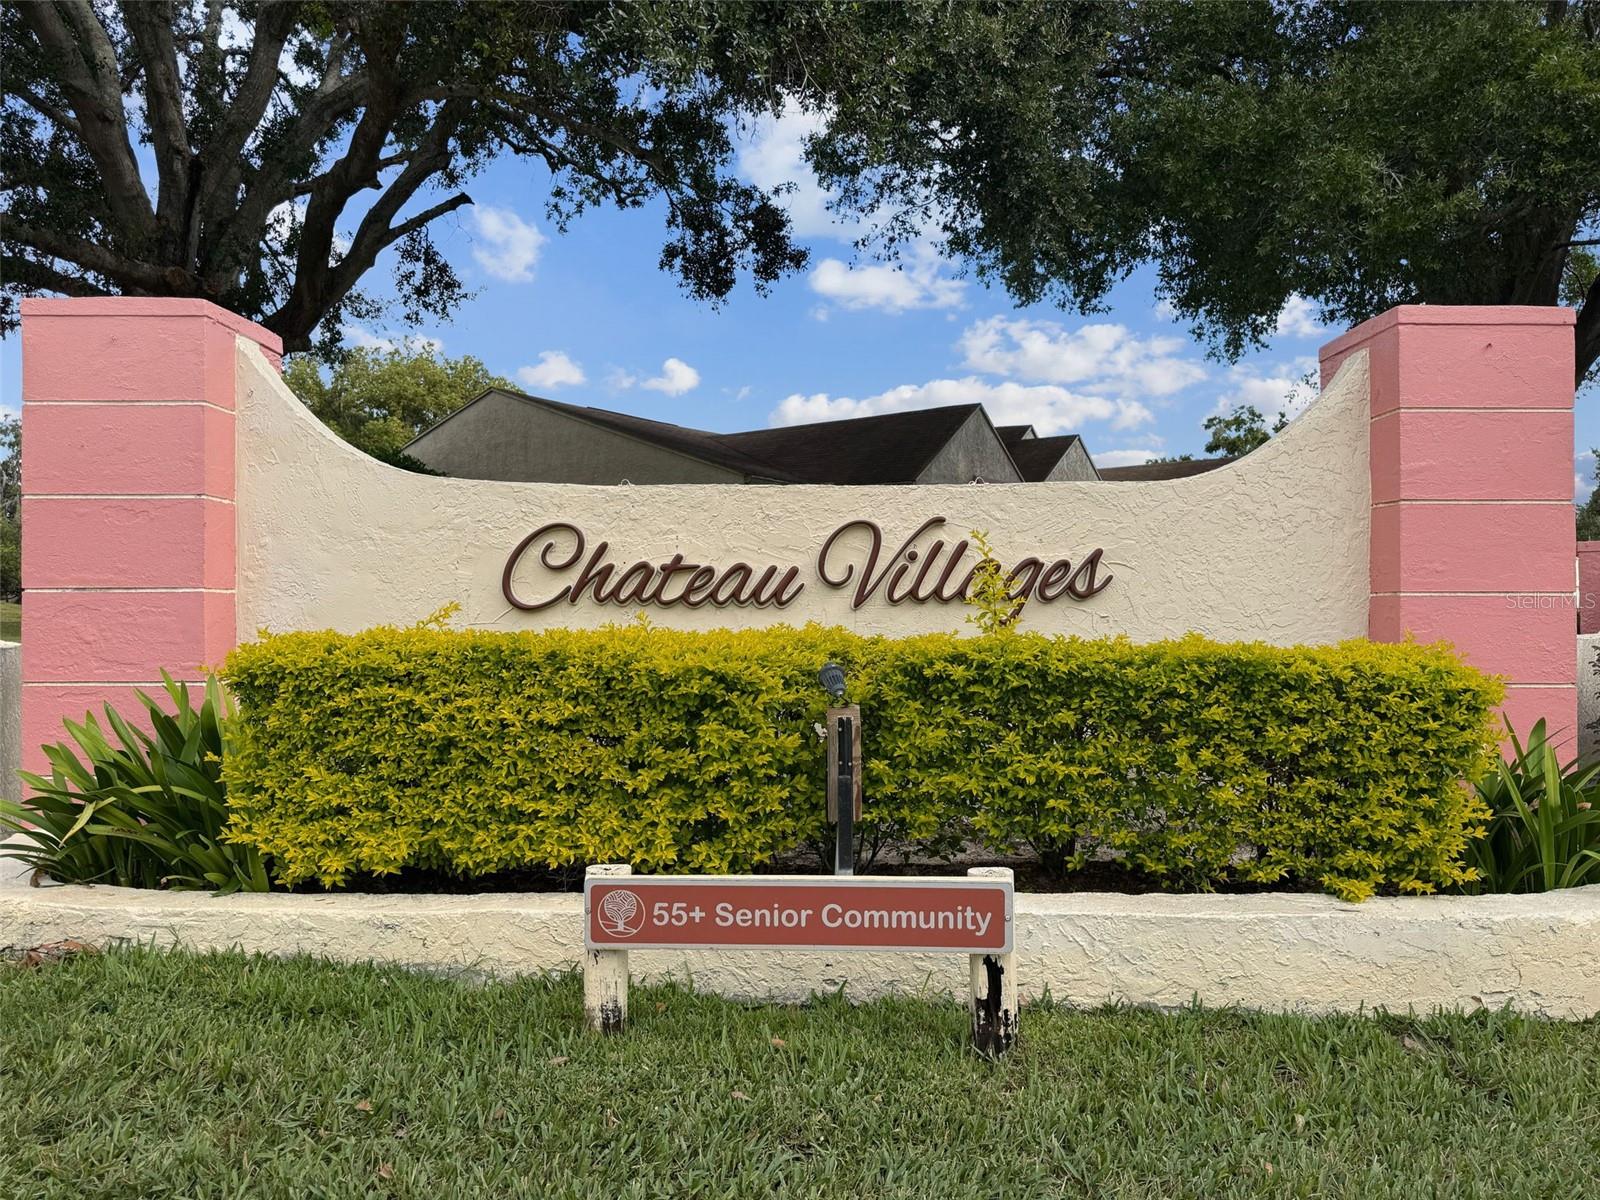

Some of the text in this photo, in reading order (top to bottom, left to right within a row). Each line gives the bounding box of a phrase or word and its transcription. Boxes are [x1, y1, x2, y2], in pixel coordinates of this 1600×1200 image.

[502, 522, 806, 610] Chateau
[652, 902, 992, 936] 55+ Senior Community
